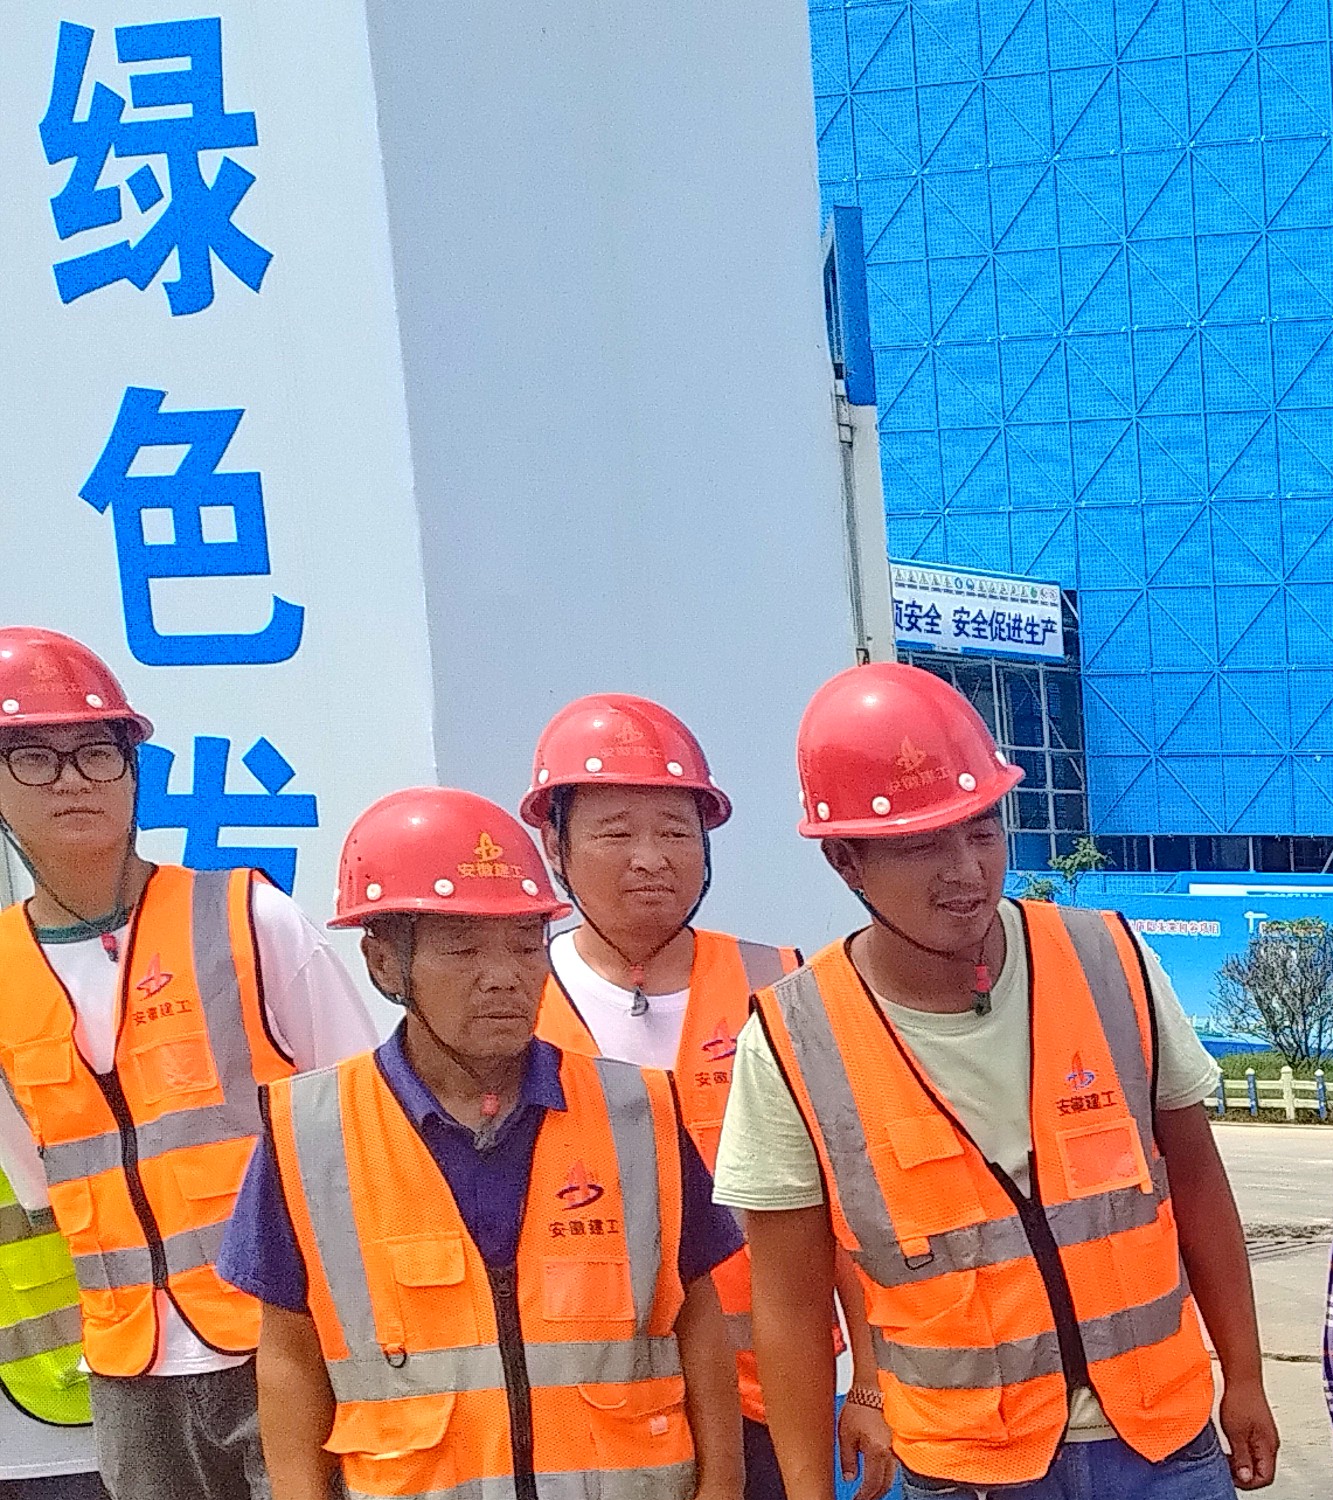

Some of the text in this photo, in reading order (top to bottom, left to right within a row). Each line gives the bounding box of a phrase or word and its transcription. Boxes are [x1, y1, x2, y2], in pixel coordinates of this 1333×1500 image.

[952, 606, 1058, 646] 安全促进生产
